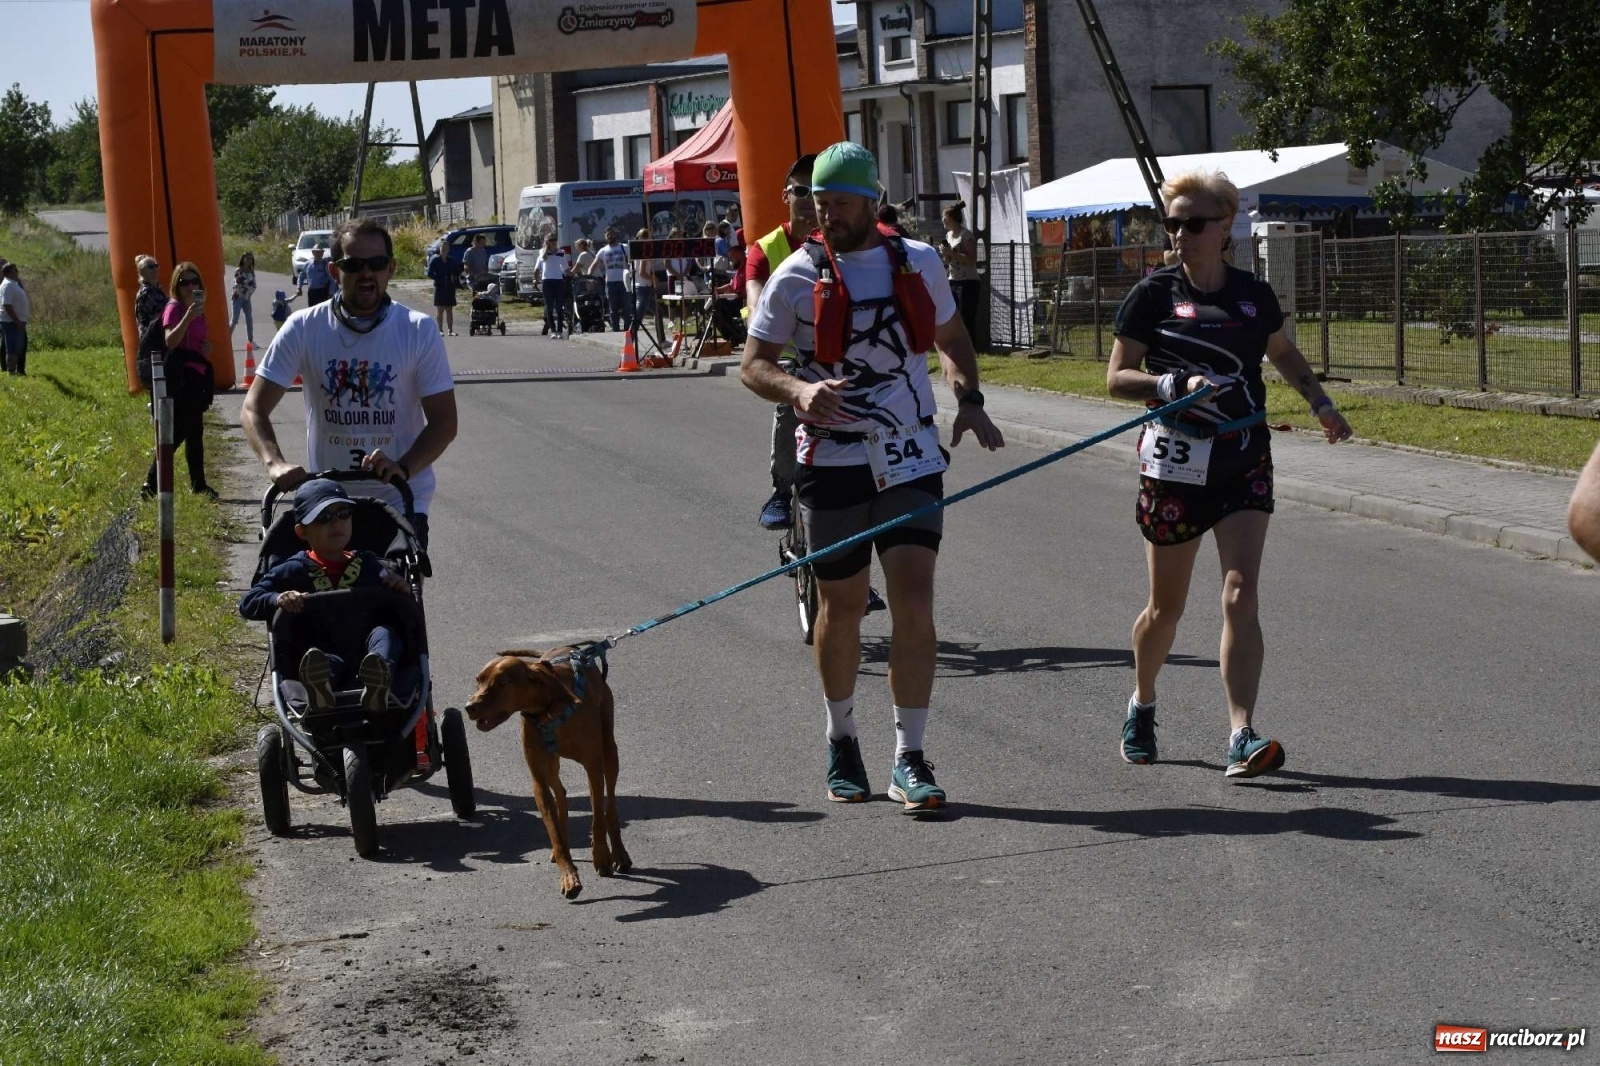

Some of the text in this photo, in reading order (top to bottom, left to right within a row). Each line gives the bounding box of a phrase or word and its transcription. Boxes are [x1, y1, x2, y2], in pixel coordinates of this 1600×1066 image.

[353, 0, 515, 62] META
[239, 36, 306, 47] MARATONY
[239, 47, 307, 57] POLSKIE.PL
[324, 409, 396, 425] COLOUR RUN
[329, 435, 392, 448] COLOUR RUN
[884, 438, 924, 466] 54
[1153, 436, 1191, 465] 53
